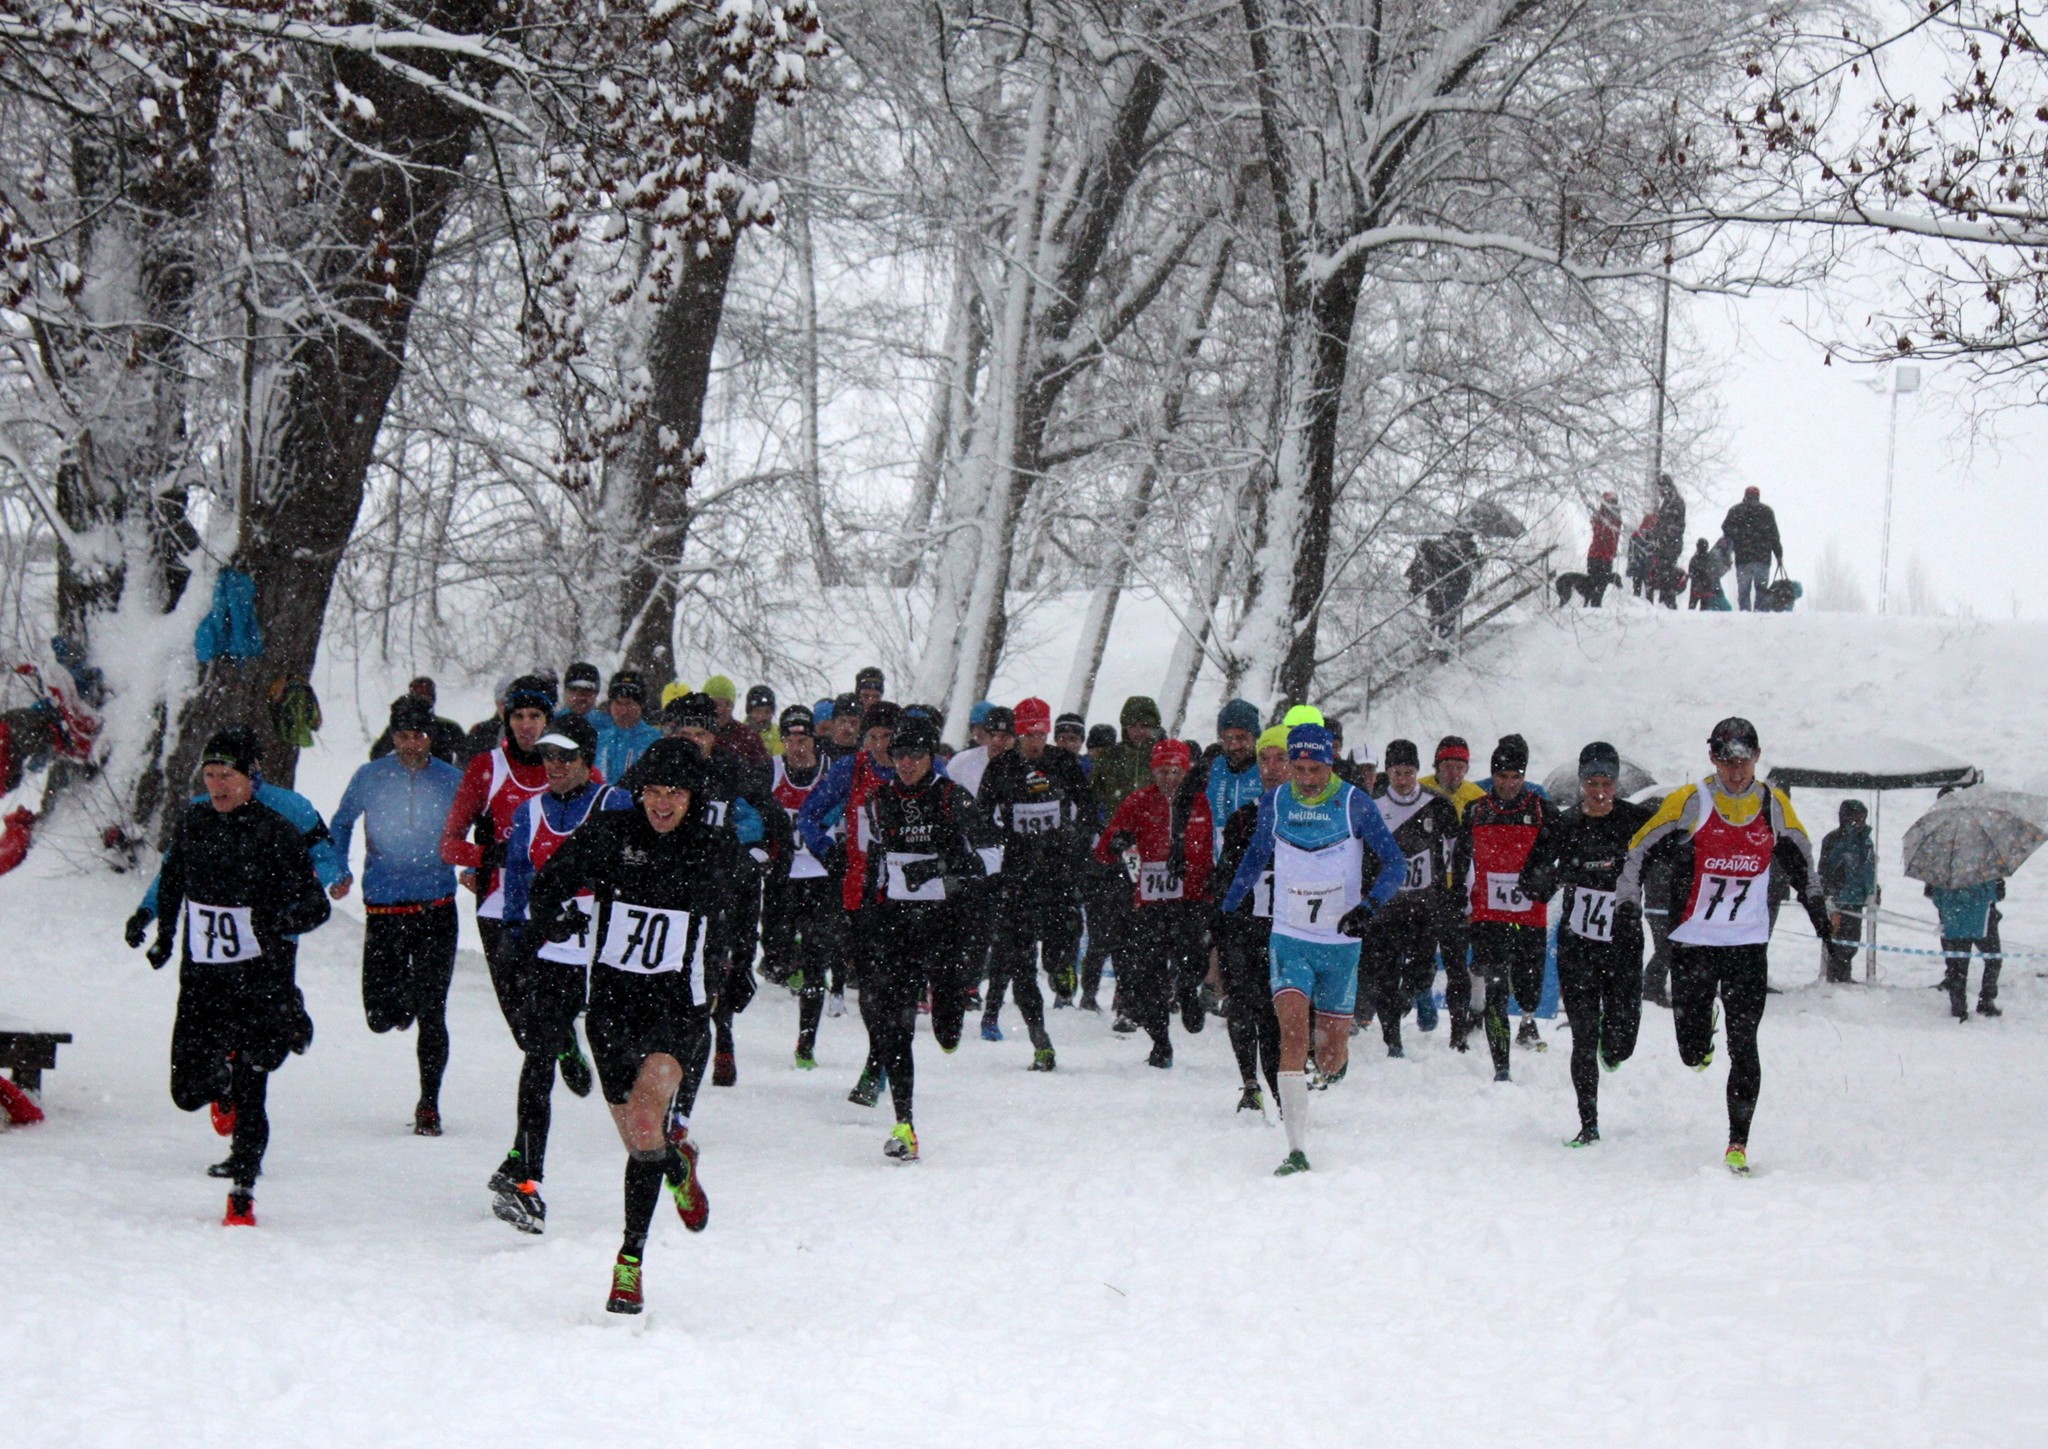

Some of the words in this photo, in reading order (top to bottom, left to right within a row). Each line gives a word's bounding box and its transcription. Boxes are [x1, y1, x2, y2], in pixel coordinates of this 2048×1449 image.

[1288, 811, 1331, 820] hellblau.
[900, 825, 934, 835] SPORT
[1704, 858, 1759, 871] GRAVAG
[1307, 898, 1322, 923] 7
[1704, 877, 1752, 921] 77
[199, 908, 240, 958] 79
[620, 909, 669, 969] 70
